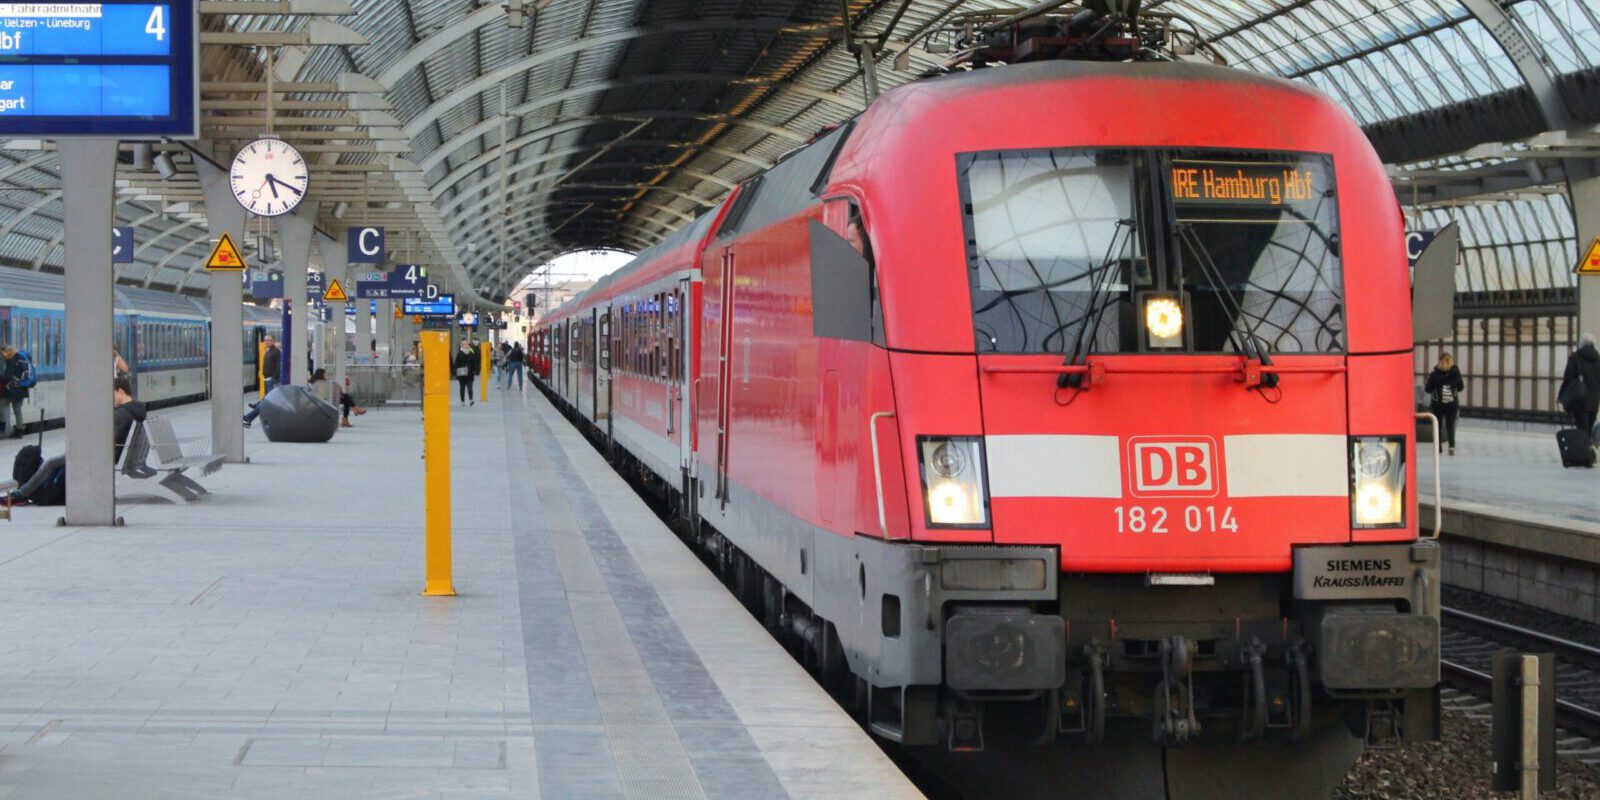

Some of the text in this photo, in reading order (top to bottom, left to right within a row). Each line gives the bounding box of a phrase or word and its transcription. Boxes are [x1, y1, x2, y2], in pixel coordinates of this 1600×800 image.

[4, 18, 38, 28] Uelzen
[46, 18, 91, 30] Lüneburg
[145, 6, 166, 41] 4
[0, 31, 21, 49] bf
[1172, 169, 1313, 205] IRE Hamburg Hbf
[358, 227, 380, 256] C
[1405, 232, 1424, 260] C
[404, 265, 418, 284] 4
[426, 284, 438, 299] D
[1140, 446, 1208, 487] DB
[1114, 505, 1239, 534] 182 014
[1327, 560, 1392, 572] SIEMENS
